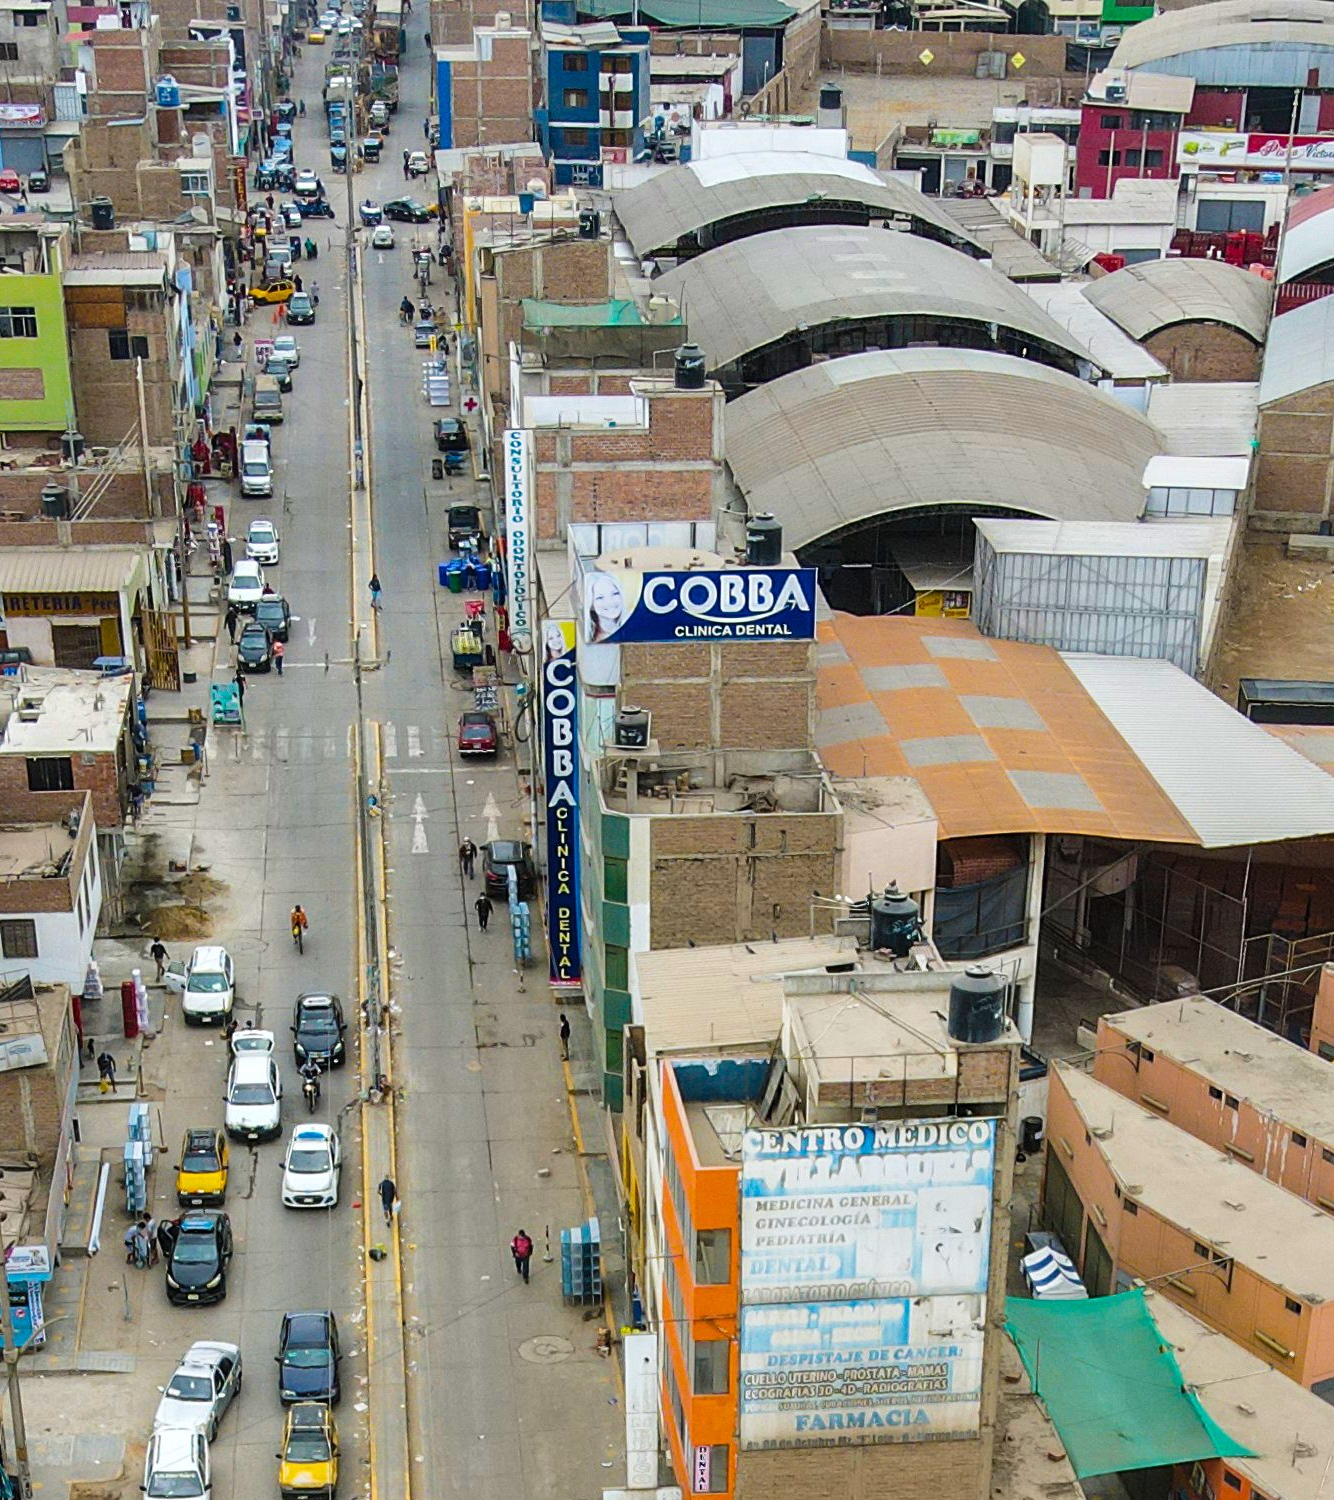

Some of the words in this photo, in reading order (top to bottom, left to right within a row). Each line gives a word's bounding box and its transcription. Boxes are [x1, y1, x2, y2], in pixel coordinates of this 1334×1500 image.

[510, 431, 524, 524] CONSULTORIO
[643, 574, 810, 614] COBBA
[675, 625, 732, 638] CLINICA
[735, 624, 792, 636] DENTAL
[546, 658, 577, 807] COBBA
[555, 807, 570, 895] CLINICA
[558, 907, 572, 981] DENTAL
[743, 1128, 865, 1153] CENTRO
[756, 1197, 834, 1212] MEDICINA
[839, 1193, 911, 1208] GENERAL
[750, 1255, 830, 1275] DENTAL
[768, 1351, 862, 1367] DESPISTAJE
[869, 1348, 888, 1361] DE
[744, 1371, 787, 1386] CUELLO
[908, 1363, 947, 1376] MAMAS
[795, 1409, 930, 1431] FARMACIA
[698, 1446, 708, 1492] DENTAL
